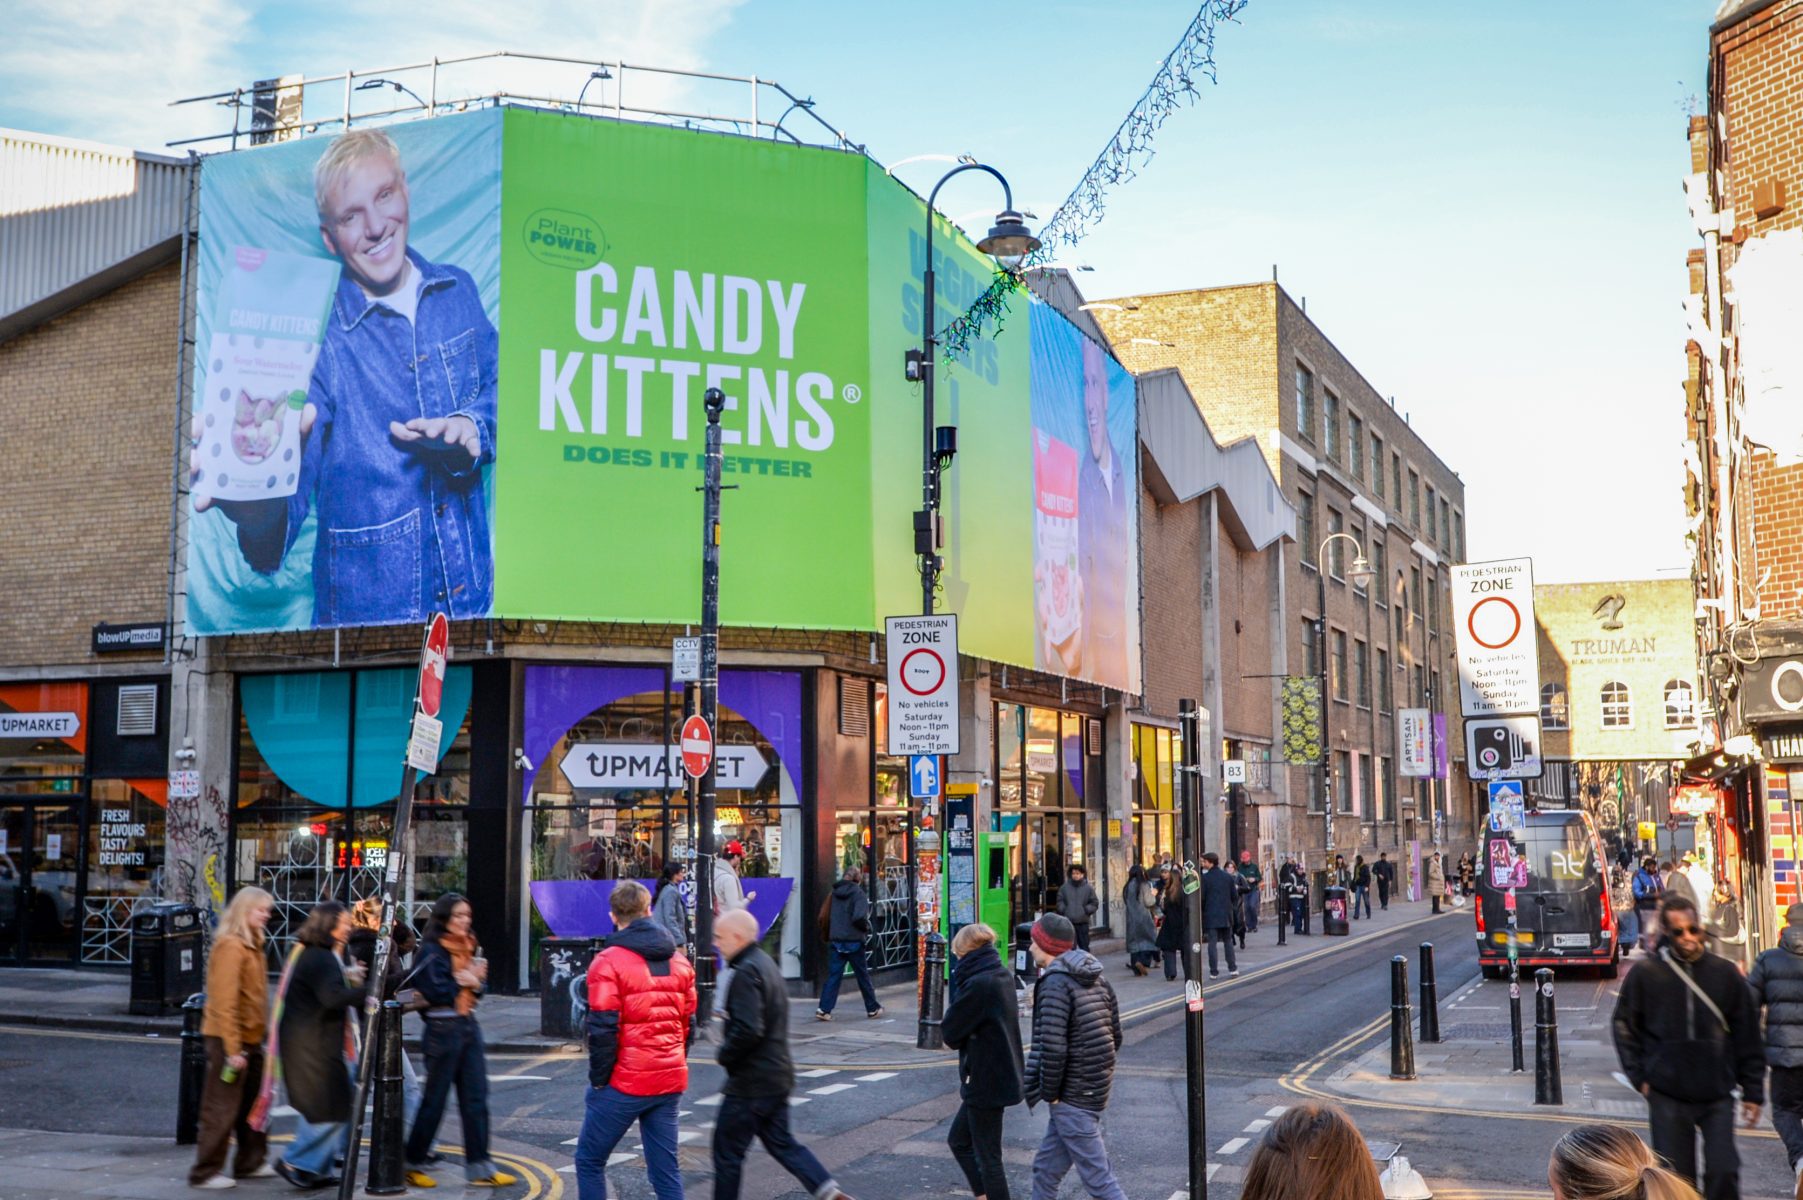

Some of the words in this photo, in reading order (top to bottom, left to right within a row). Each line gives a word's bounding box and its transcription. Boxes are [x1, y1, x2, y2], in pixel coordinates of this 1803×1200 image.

[539, 218, 592, 240] Plant
[530, 230, 597, 255] POWER
[575, 262, 807, 359] CANDY
[229, 308, 267, 330] CANDY
[269, 314, 320, 336] KITTENS
[563, 444, 652, 467] DOES
[660, 451, 688, 470] IT
[1460, 565, 1522, 577] PEDESTRIAN
[1471, 578, 1514, 593] ZONE
[894, 620, 948, 629] PEDESTRIAN
[902, 631, 941, 644] ZONE
[675, 640, 699, 648] CCTV
[1571, 637, 1656, 655] TRUMAN
[1469, 656, 1483, 664] No
[1476, 668, 1519, 678] Saturday
[1472, 680, 1496, 689] Noon
[1482, 690, 1518, 699] Sunday
[914, 700, 949, 709] vehicles
[1473, 702, 1481, 710] 11
[904, 713, 943, 722] Saturday
[2, 718, 70, 732] UPMARKET
[899, 723, 922, 731] Noon
[909, 733, 940, 741] Sunday
[1404, 717, 1412, 763] ARTISAN
[936, 743, 950, 751] pm
[1769, 733, 1803, 758] THA
[1228, 766, 1242, 777] 83
[101, 810, 130, 822] FRESH
[100, 824, 145, 836] FLAVOURS
[100, 838, 127, 850] TASTY
[365, 847, 386, 857] ICED
[99, 852, 145, 865] DELIGHTS!
[365, 857, 387, 867] CHAI
